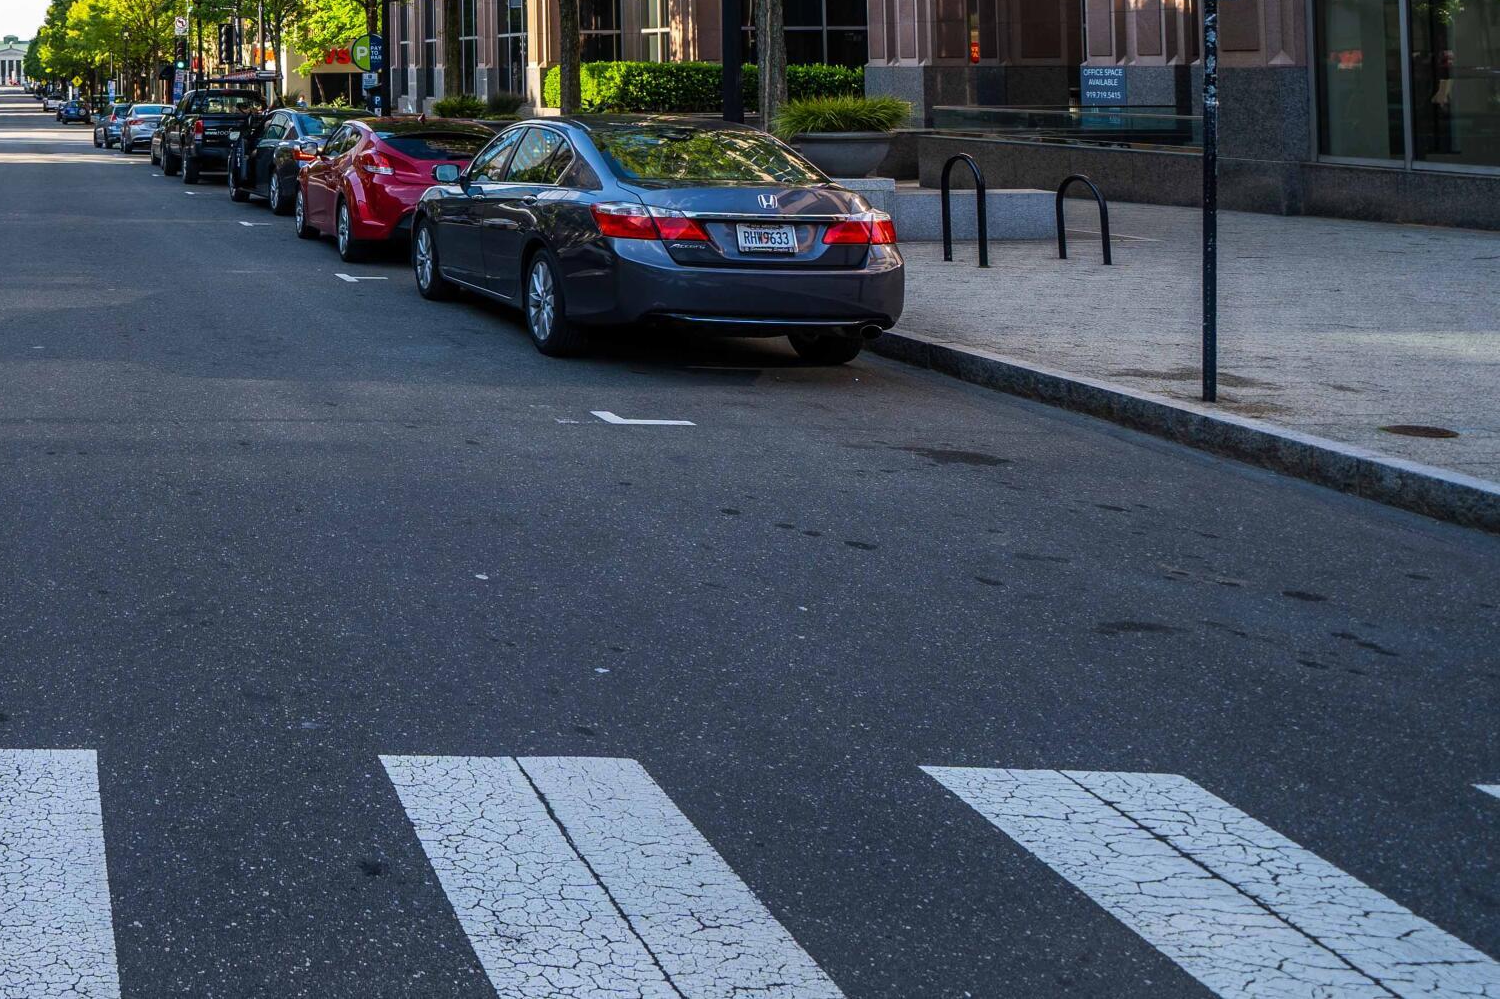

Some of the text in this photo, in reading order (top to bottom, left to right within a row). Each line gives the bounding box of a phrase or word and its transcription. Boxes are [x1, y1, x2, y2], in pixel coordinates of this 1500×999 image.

[356, 46, 368, 61] P
[1083, 68, 1123, 76] OFFICE SPACE
[1088, 78, 1119, 86] AVAILABLE
